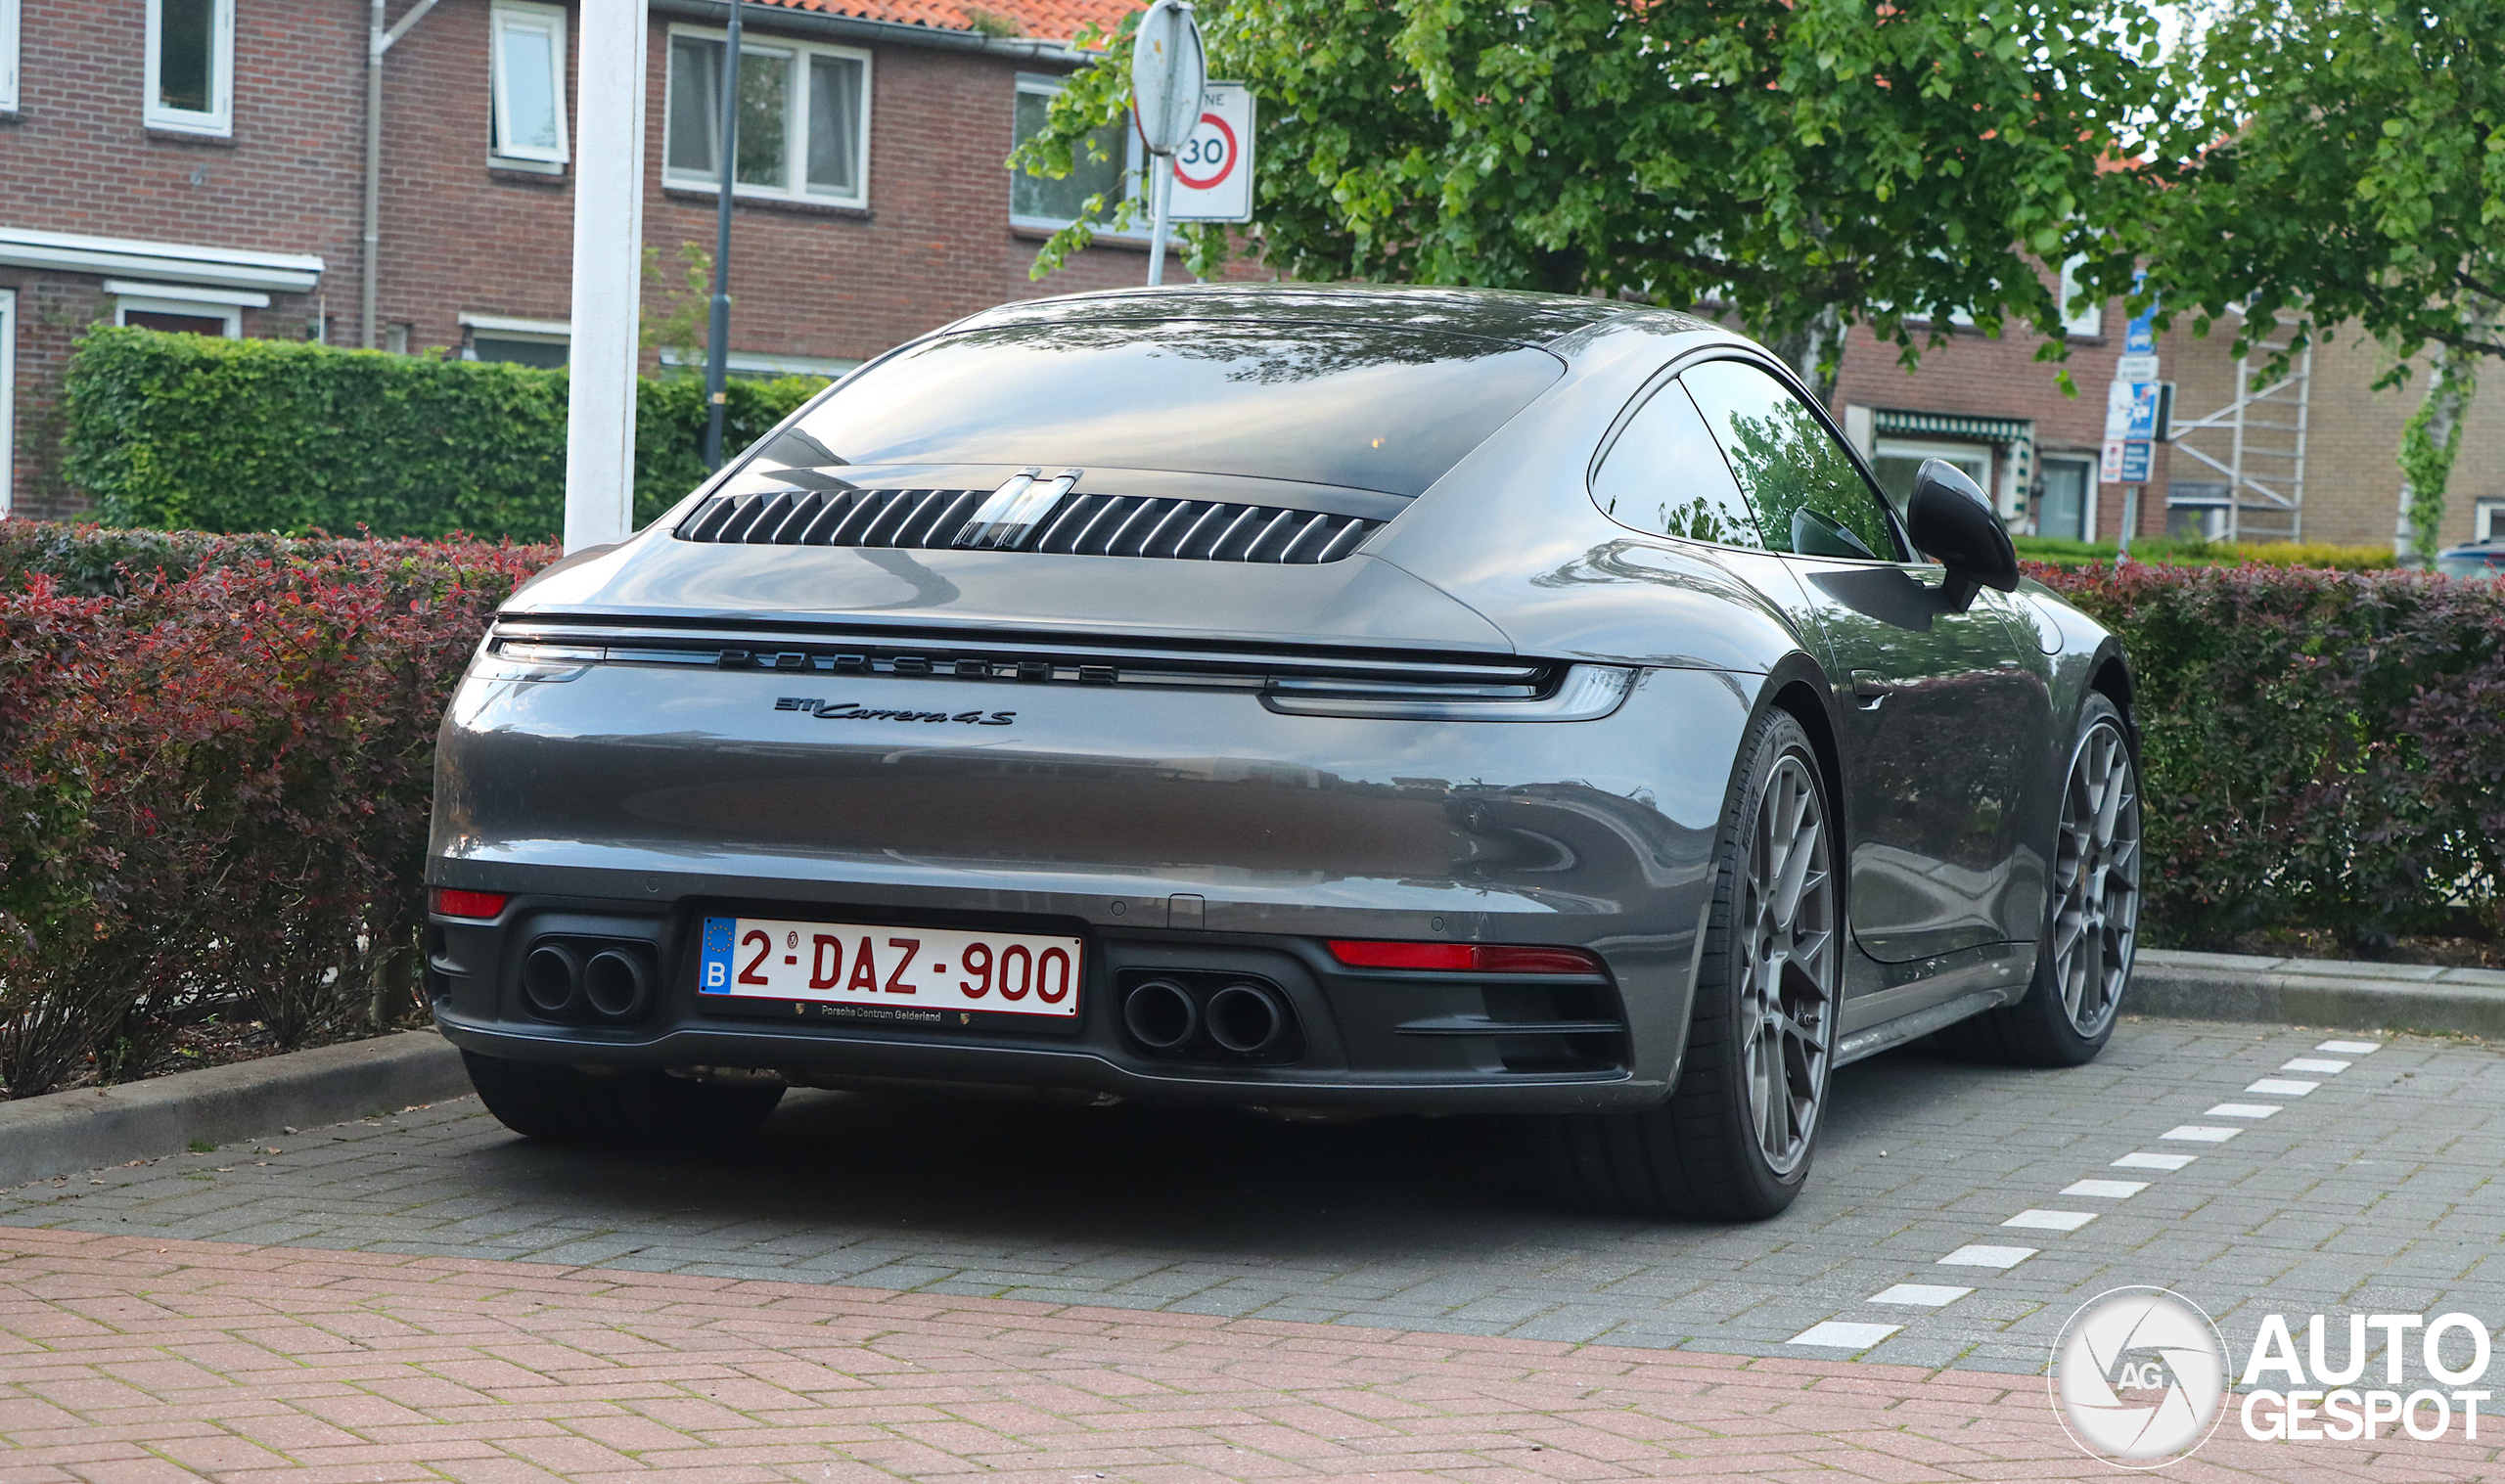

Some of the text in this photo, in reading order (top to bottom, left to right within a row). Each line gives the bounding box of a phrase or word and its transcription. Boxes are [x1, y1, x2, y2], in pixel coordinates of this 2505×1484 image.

[1204, 93, 1225, 107] NE
[1181, 138, 1223, 164] 30
[717, 649, 1118, 685] PORSCHE
[774, 697, 827, 711] 911
[813, 702, 948, 723] Carrera
[706, 929, 1070, 1005] B 2-DAZ-900
[821, 1005, 941, 1022] Porsche Centrum Gelderland
